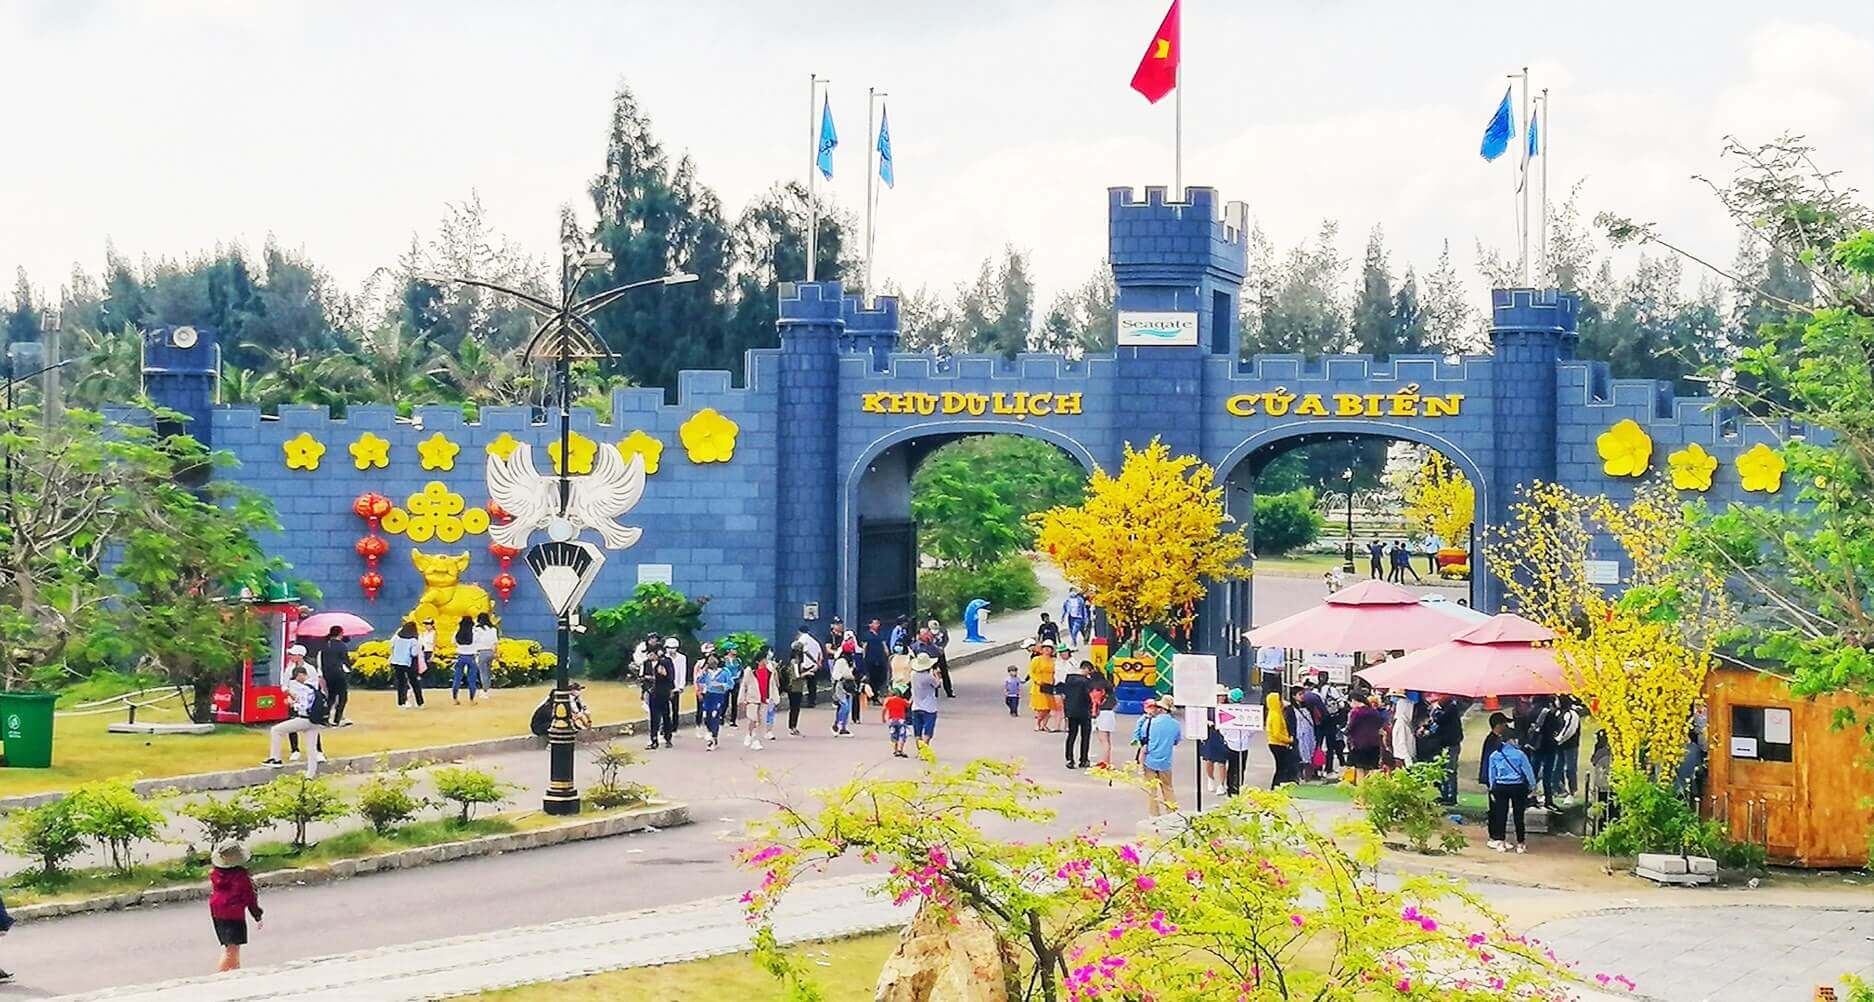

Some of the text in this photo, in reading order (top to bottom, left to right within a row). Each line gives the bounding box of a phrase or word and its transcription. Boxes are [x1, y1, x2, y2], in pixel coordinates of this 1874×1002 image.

[1121, 319, 1193, 330] Seagate
[862, 391, 1083, 421] KHU DU LỊCH
[1226, 382, 1465, 417] CỬA BIỂN
